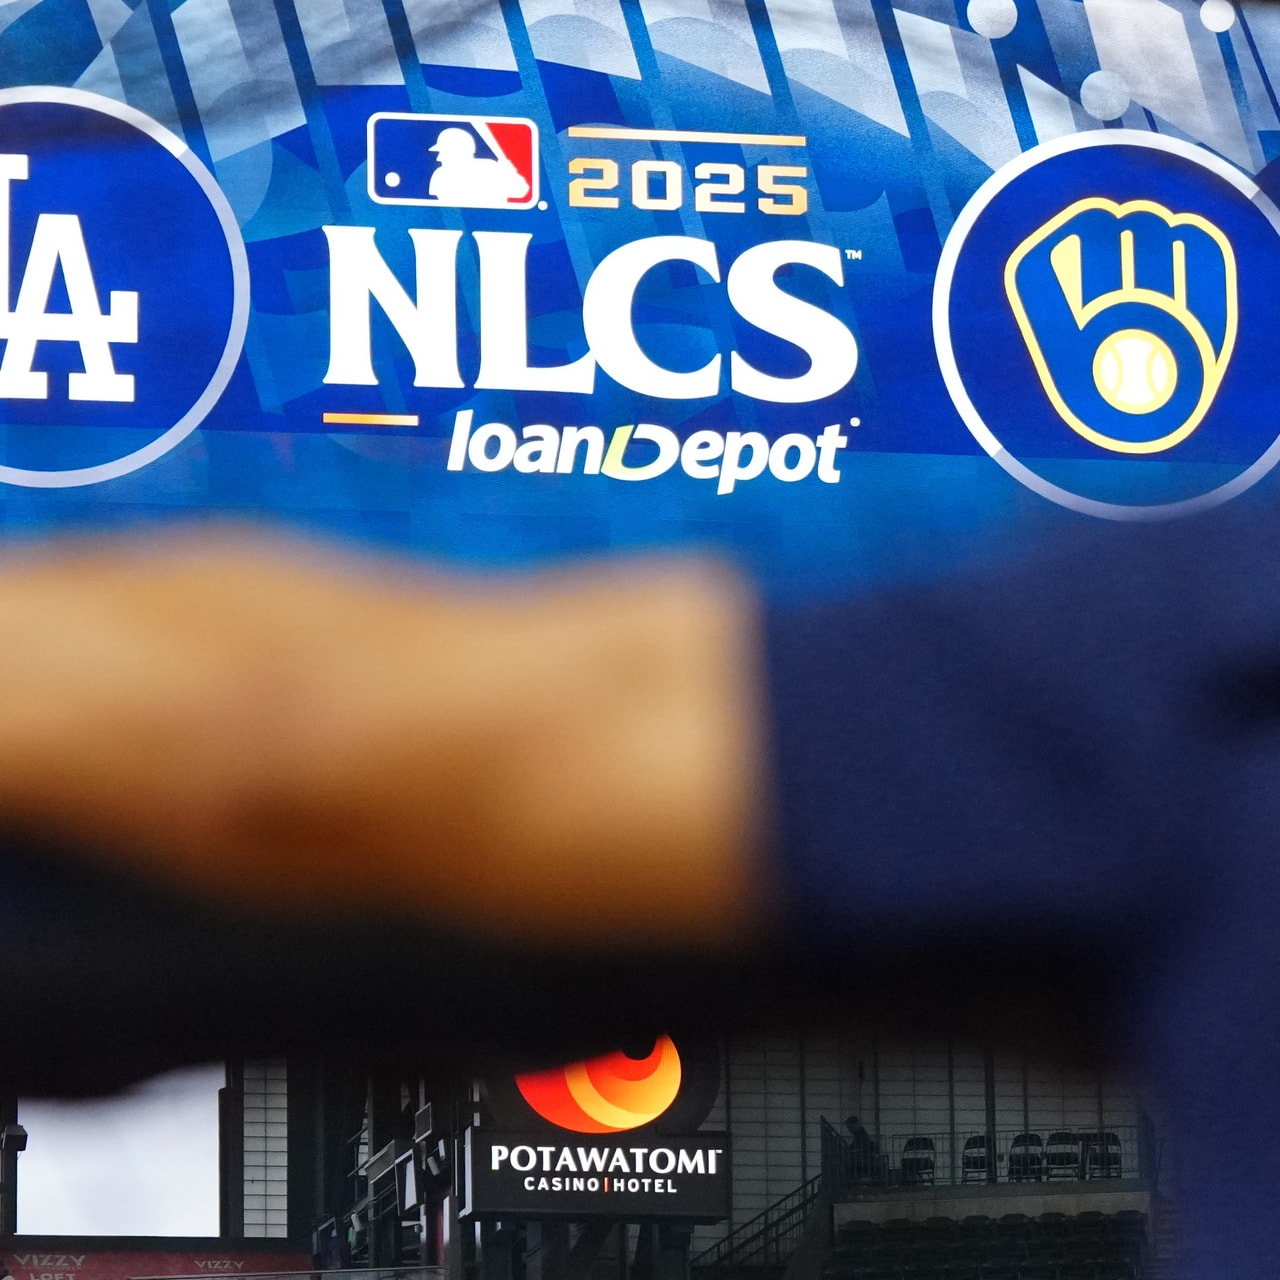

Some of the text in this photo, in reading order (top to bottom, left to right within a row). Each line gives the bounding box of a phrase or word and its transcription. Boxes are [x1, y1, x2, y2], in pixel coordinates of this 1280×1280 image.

[568, 157, 808, 216] 2025
[322, 225, 858, 403] NLCS
[447, 409, 848, 495] loanDepot
[491, 1145, 717, 1174] POTAWATOMI
[524, 1177, 677, 1193] CASINO HOTEL
[13, 1254, 86, 1266] VIZZY
[194, 1260, 245, 1269] VIZZY
